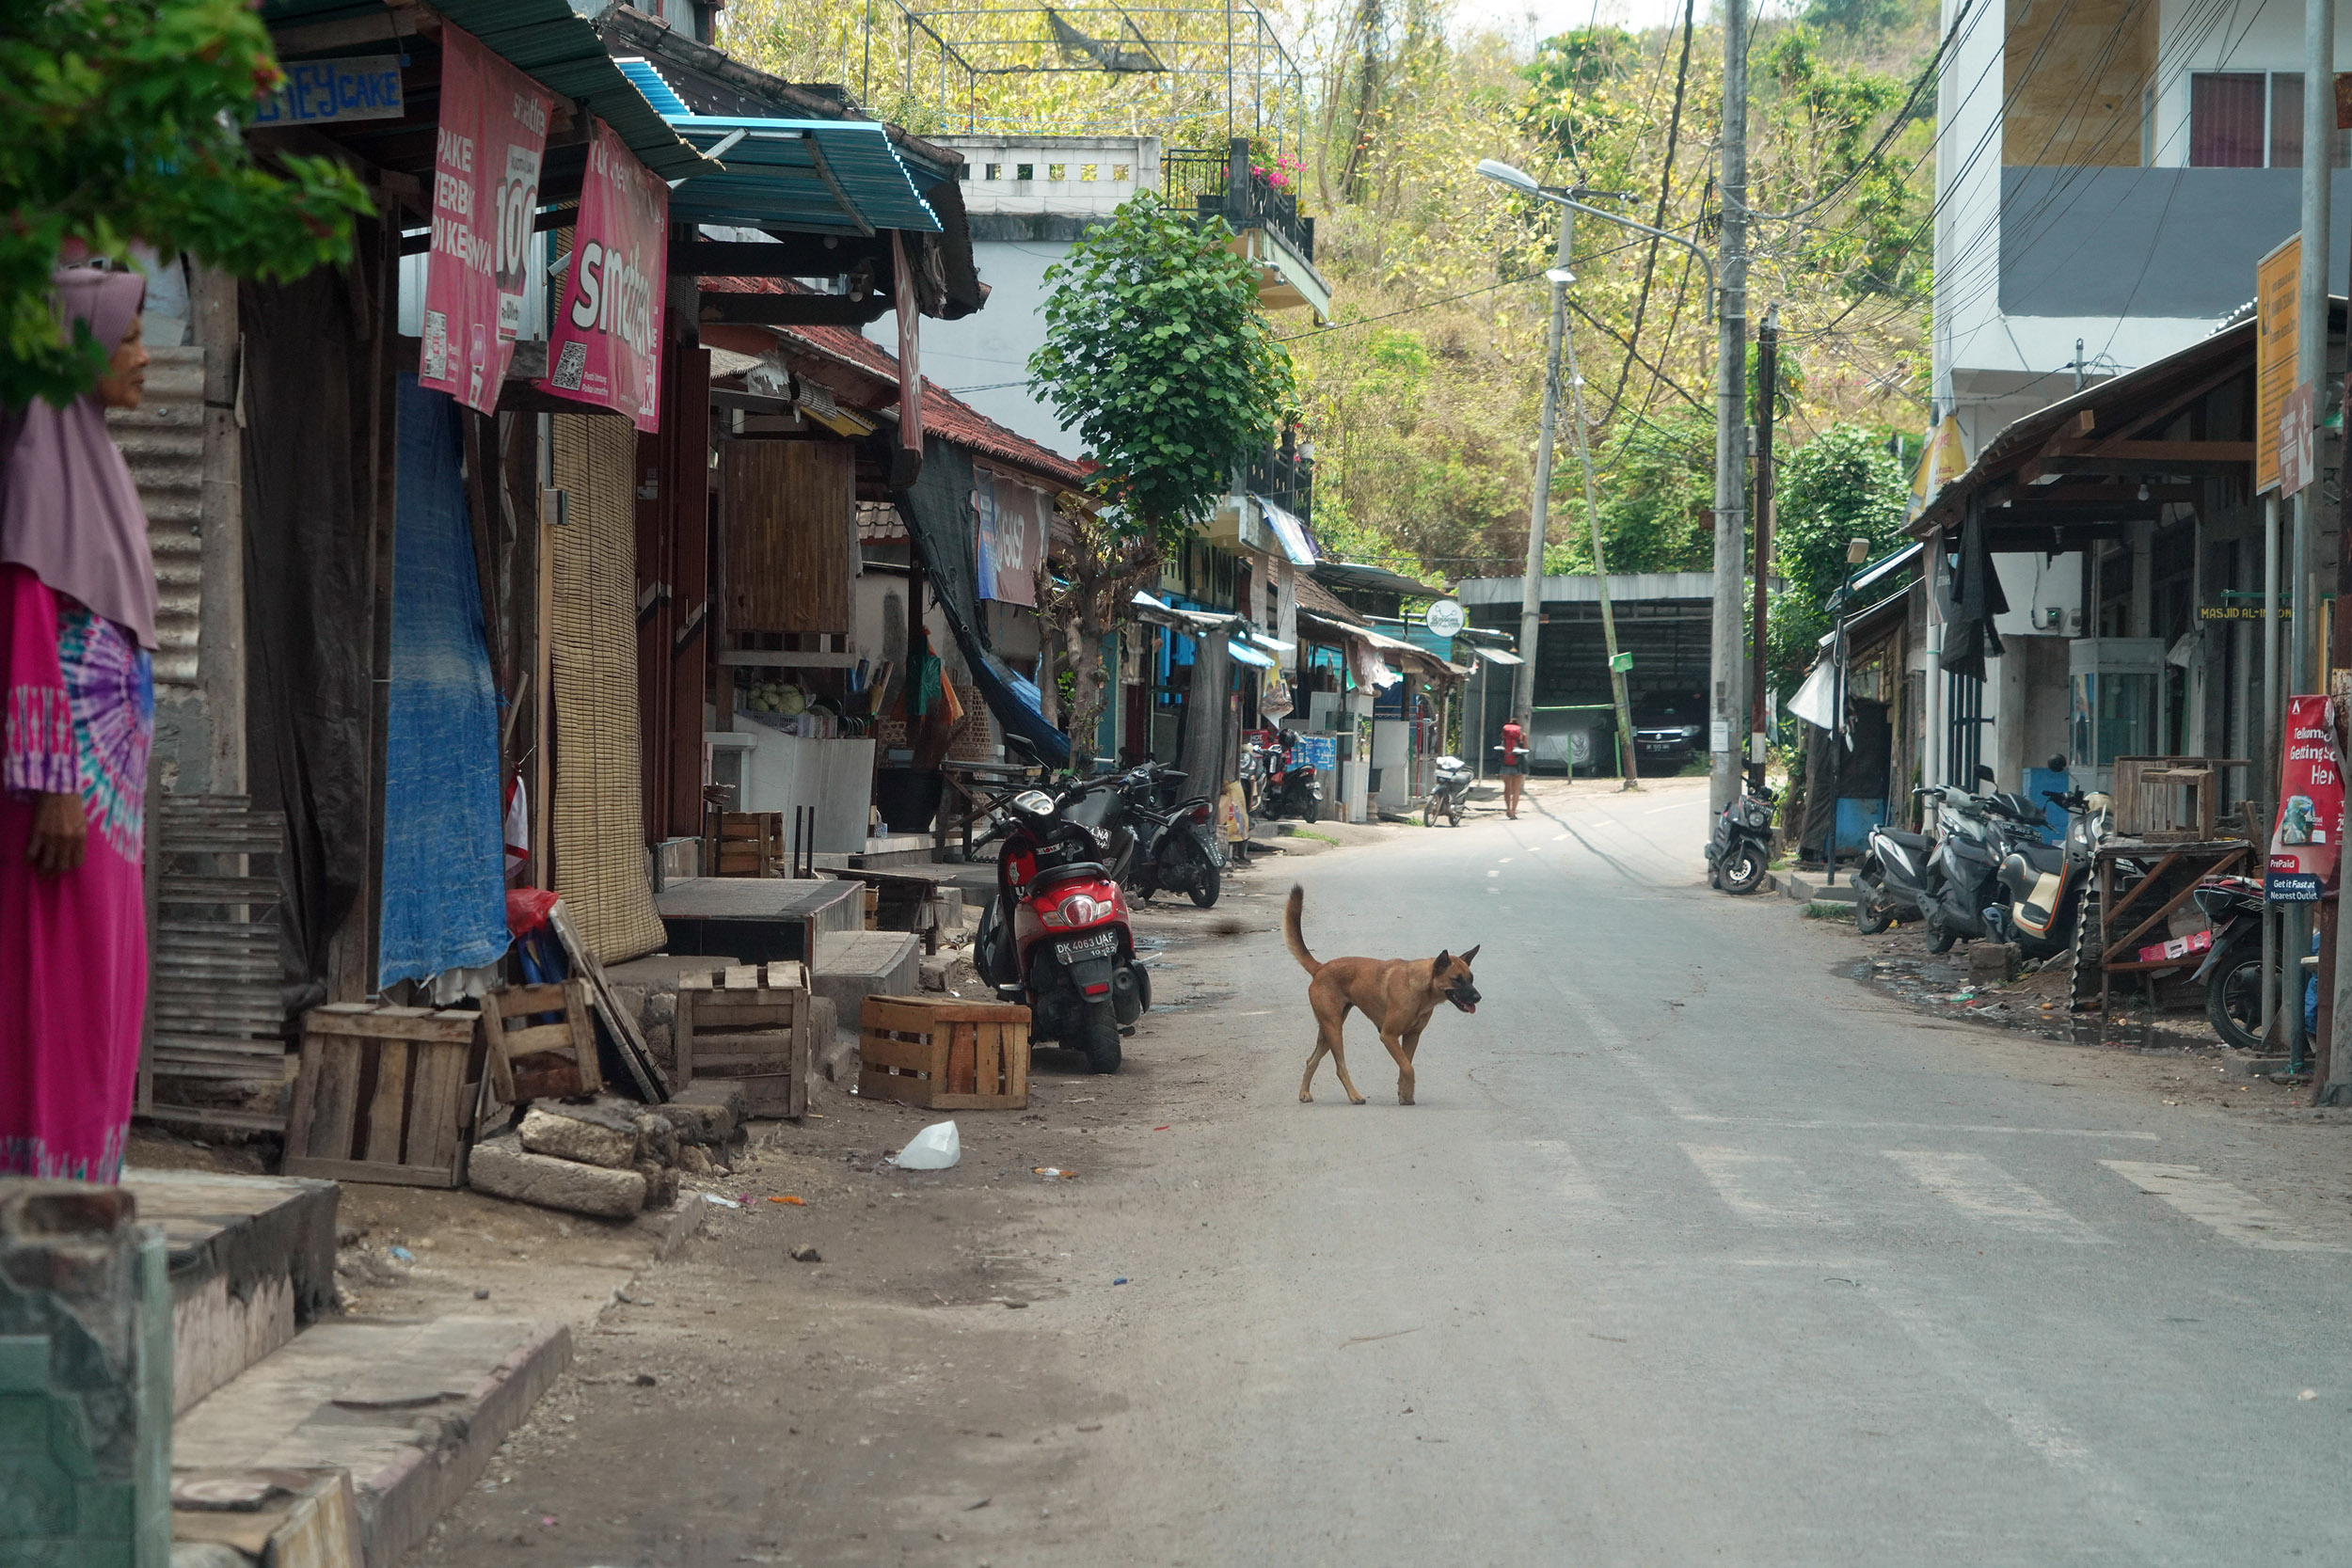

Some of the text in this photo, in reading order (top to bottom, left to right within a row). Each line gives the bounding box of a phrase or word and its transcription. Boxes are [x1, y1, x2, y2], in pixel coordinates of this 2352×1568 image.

[2201, 608, 2292, 619] MASJID AL-ION
[2290, 744, 2323, 761] Getting
[2270, 859, 2295, 869] PrePaid
[2274, 879, 2315, 889] Get it Fast at
[2271, 892, 2296, 900] Nearest
[1057, 932, 1114, 953] DK 4063 UAF
